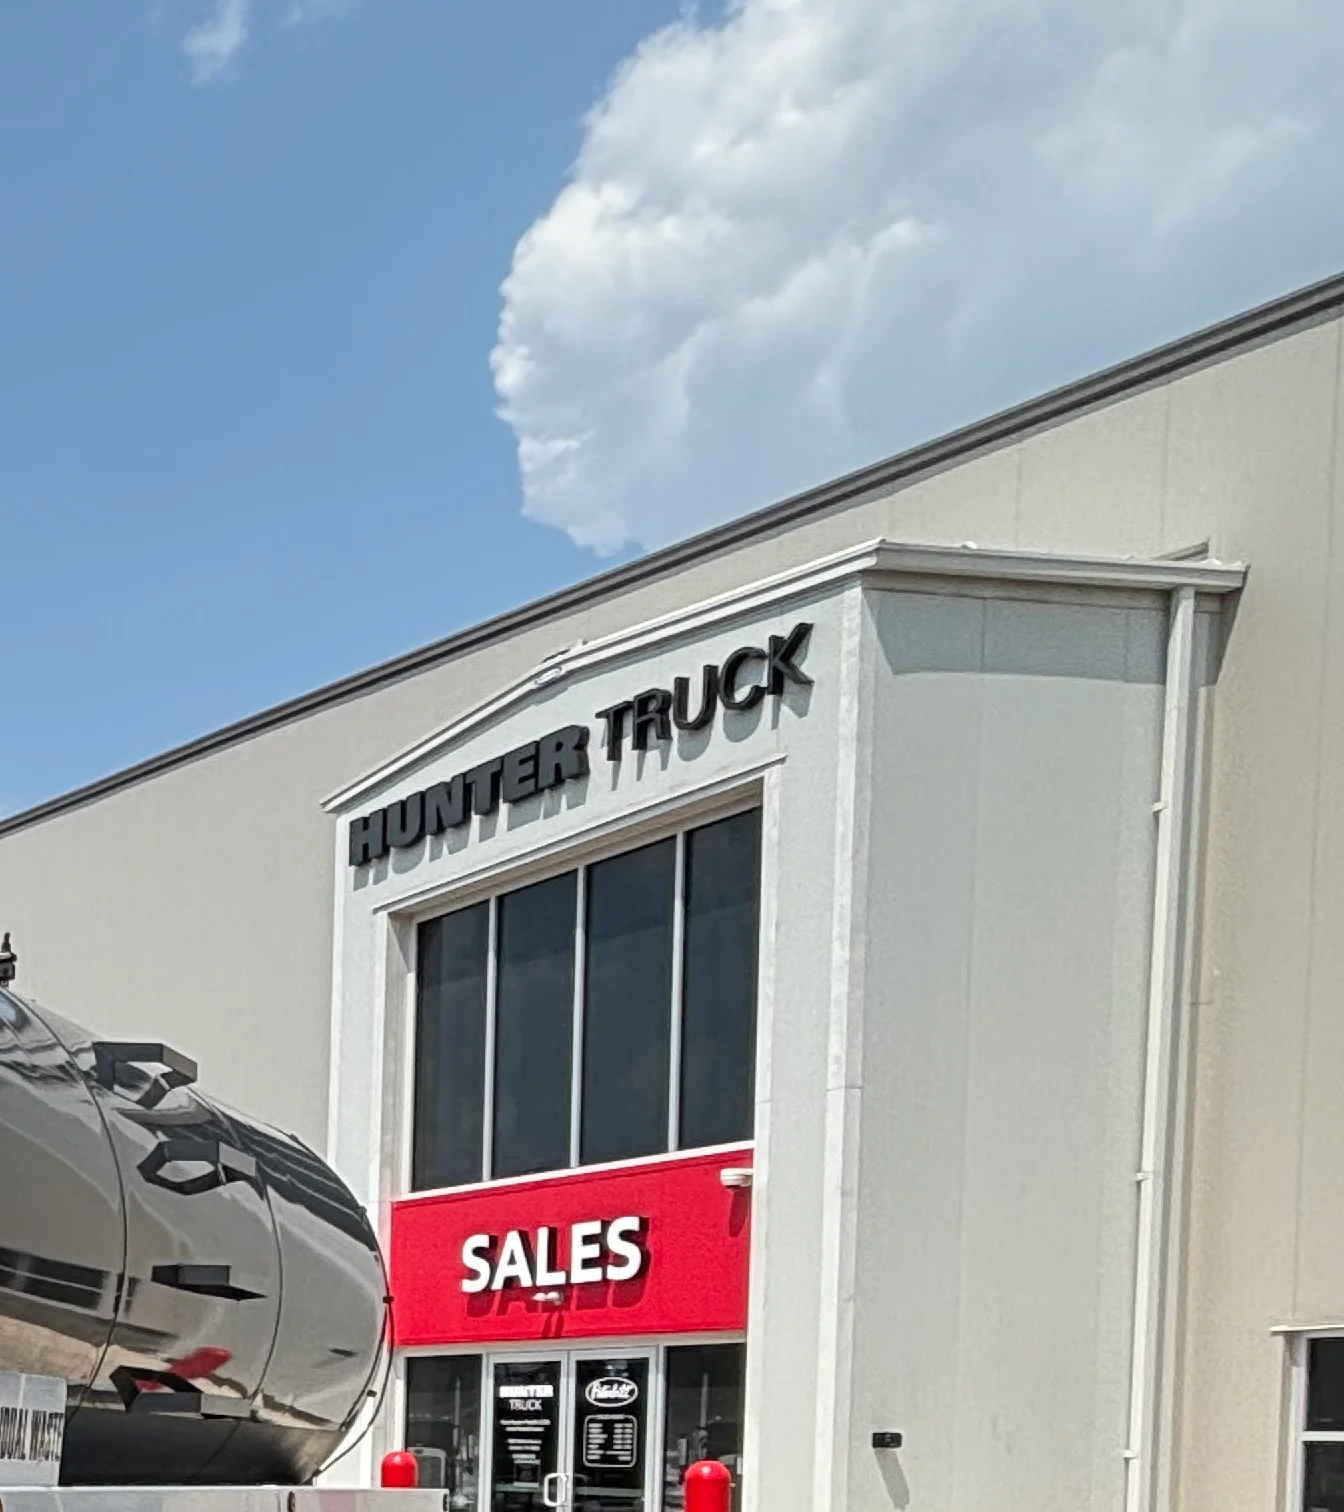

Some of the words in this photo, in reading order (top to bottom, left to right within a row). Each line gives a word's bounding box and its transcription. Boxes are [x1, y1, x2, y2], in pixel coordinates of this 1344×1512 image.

[349, 724, 590, 867] HUNTER
[595, 622, 815, 762] TRUCK
[461, 1215, 645, 1293] SALES
